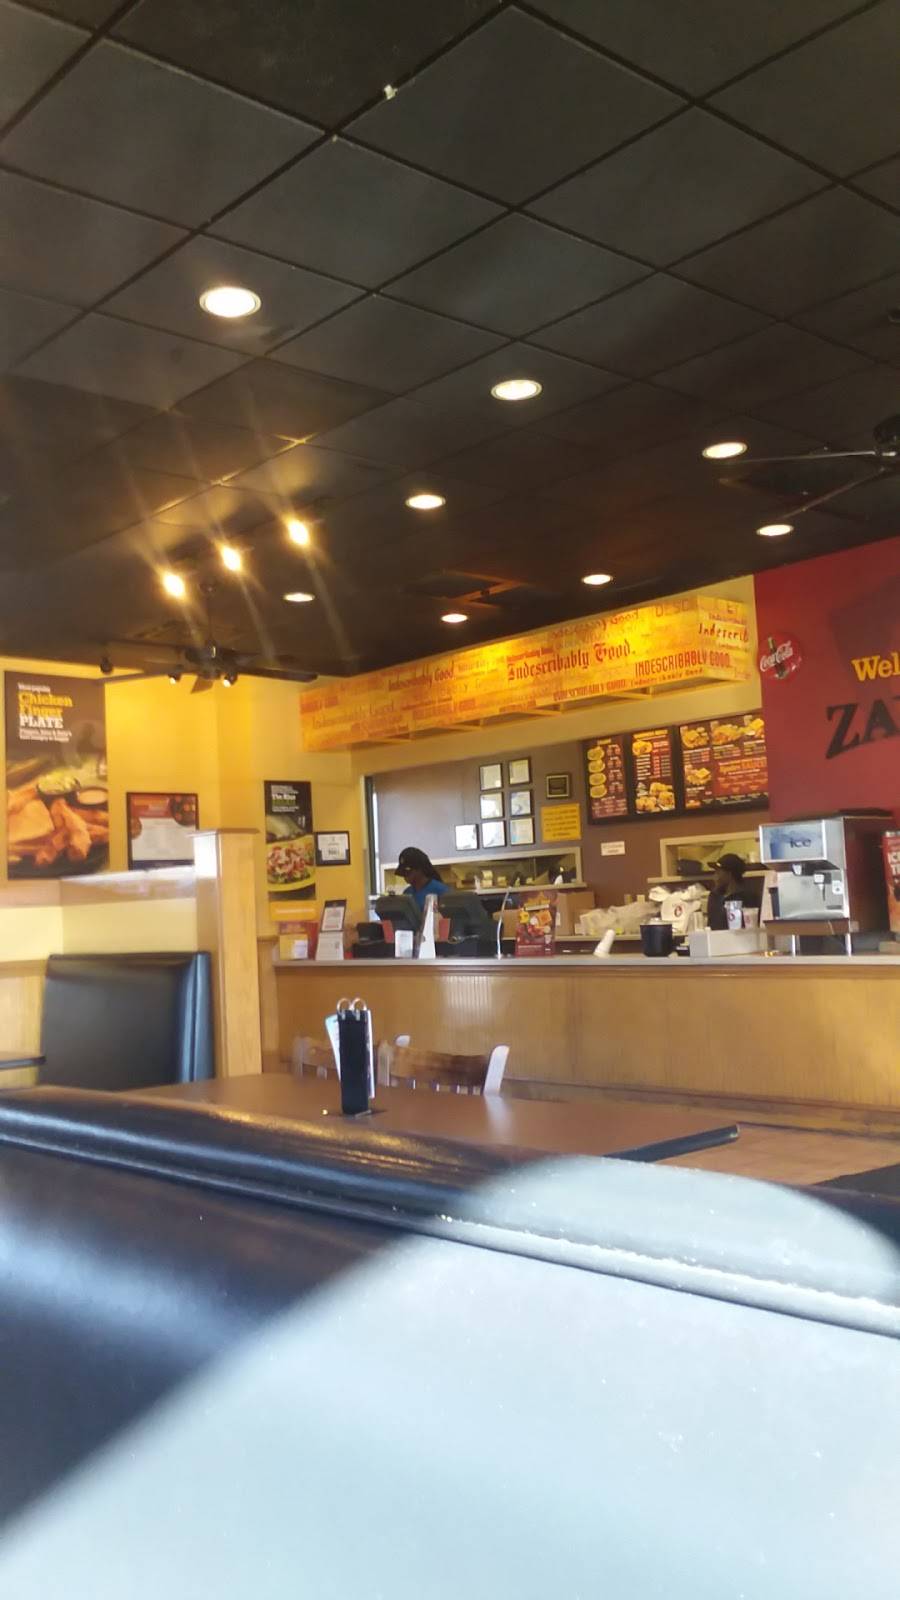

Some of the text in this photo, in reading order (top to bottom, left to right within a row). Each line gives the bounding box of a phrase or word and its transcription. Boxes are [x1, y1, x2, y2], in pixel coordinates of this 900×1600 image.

[507, 646, 591, 681] Indescribably
[635, 647, 709, 676] INDESCRIBABLY
[18, 692, 73, 707] Chicken
[19, 714, 65, 729] PLATE
[826, 696, 900, 759] ZA
